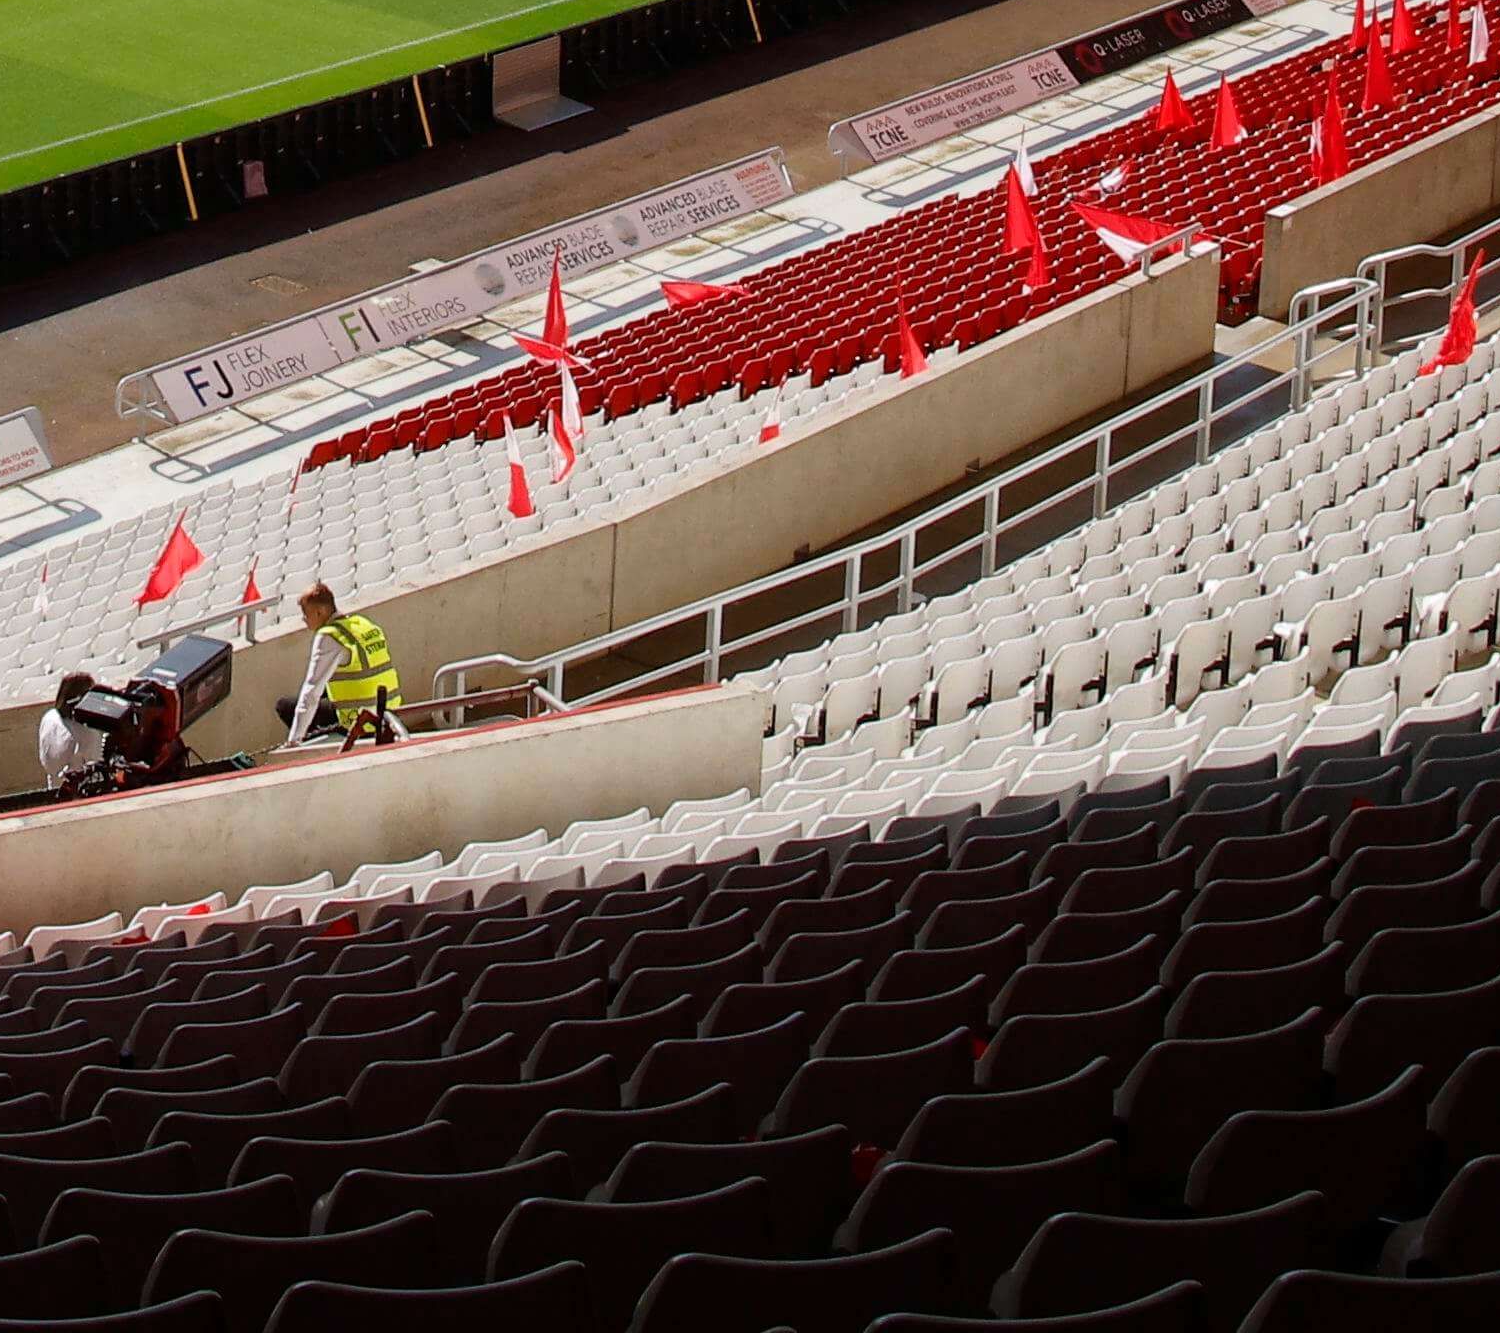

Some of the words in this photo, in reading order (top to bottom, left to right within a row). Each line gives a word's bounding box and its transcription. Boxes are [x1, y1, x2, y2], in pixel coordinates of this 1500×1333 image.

[1031, 68, 1067, 90] TCNE
[905, 100, 921, 114] NEW
[869, 124, 909, 151] TCNE
[639, 192, 698, 222] ADVANCED
[696, 179, 731, 203] BLADE
[647, 214, 686, 238] REPAIR
[686, 194, 740, 224] SERVICES
[505, 236, 569, 270] ADVANCED
[568, 224, 606, 246] BLADE
[559, 240, 615, 273] SERVICES
[377, 289, 419, 317] FLEX
[386, 295, 467, 340] INTERIORS
[339, 307, 381, 353] FI
[226, 342, 271, 371] FLEX
[241, 353, 309, 393] JOINERY
[183, 359, 235, 408] FJ
